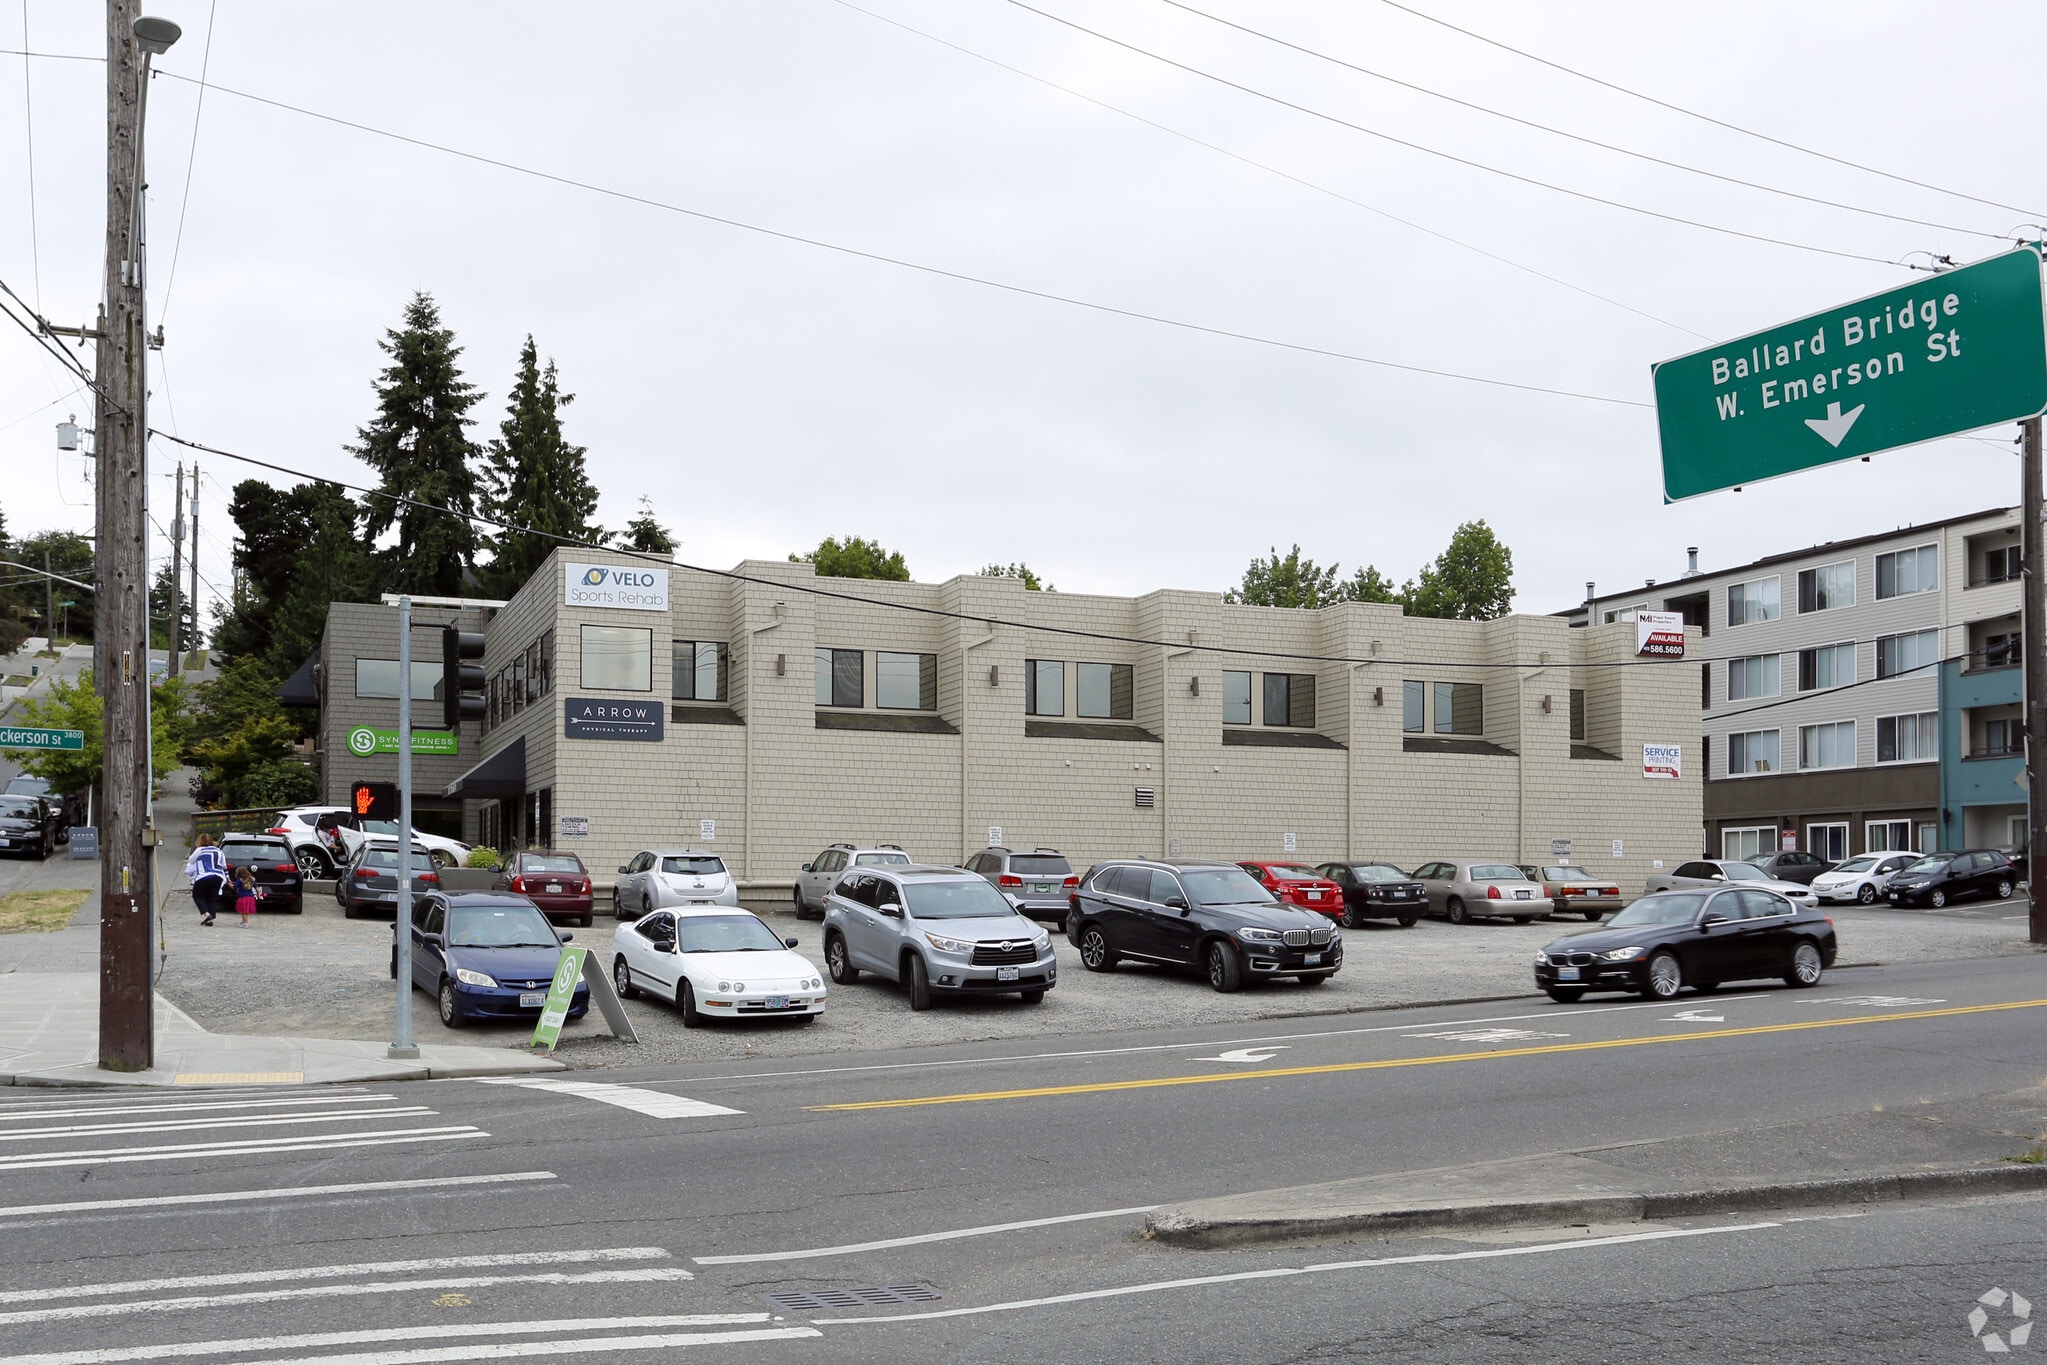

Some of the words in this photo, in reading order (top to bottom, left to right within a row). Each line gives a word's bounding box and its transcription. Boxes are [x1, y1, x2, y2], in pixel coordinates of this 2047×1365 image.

[1711, 327, 1826, 386] Ballard
[1843, 293, 1960, 347] Bridge
[1715, 391, 1745, 421] W.
[1762, 351, 1905, 410] Emerson
[1926, 328, 1961, 362] St
[612, 571, 655, 587] VELO
[571, 588, 614, 603] Sports
[618, 591, 664, 606] Rehab
[1650, 634, 1683, 643] AVAILABLE
[1650, 645, 1683, 655] 586.5600
[583, 706, 648, 718] ARROW
[0, 729, 49, 745] ckerson
[51, 735, 62, 745] St
[64, 731, 82, 739] 3800
[411, 737, 453, 745] FITNESS
[1645, 747, 1680, 757] SERVICE
[1648, 756, 1676, 765] PRINTING
